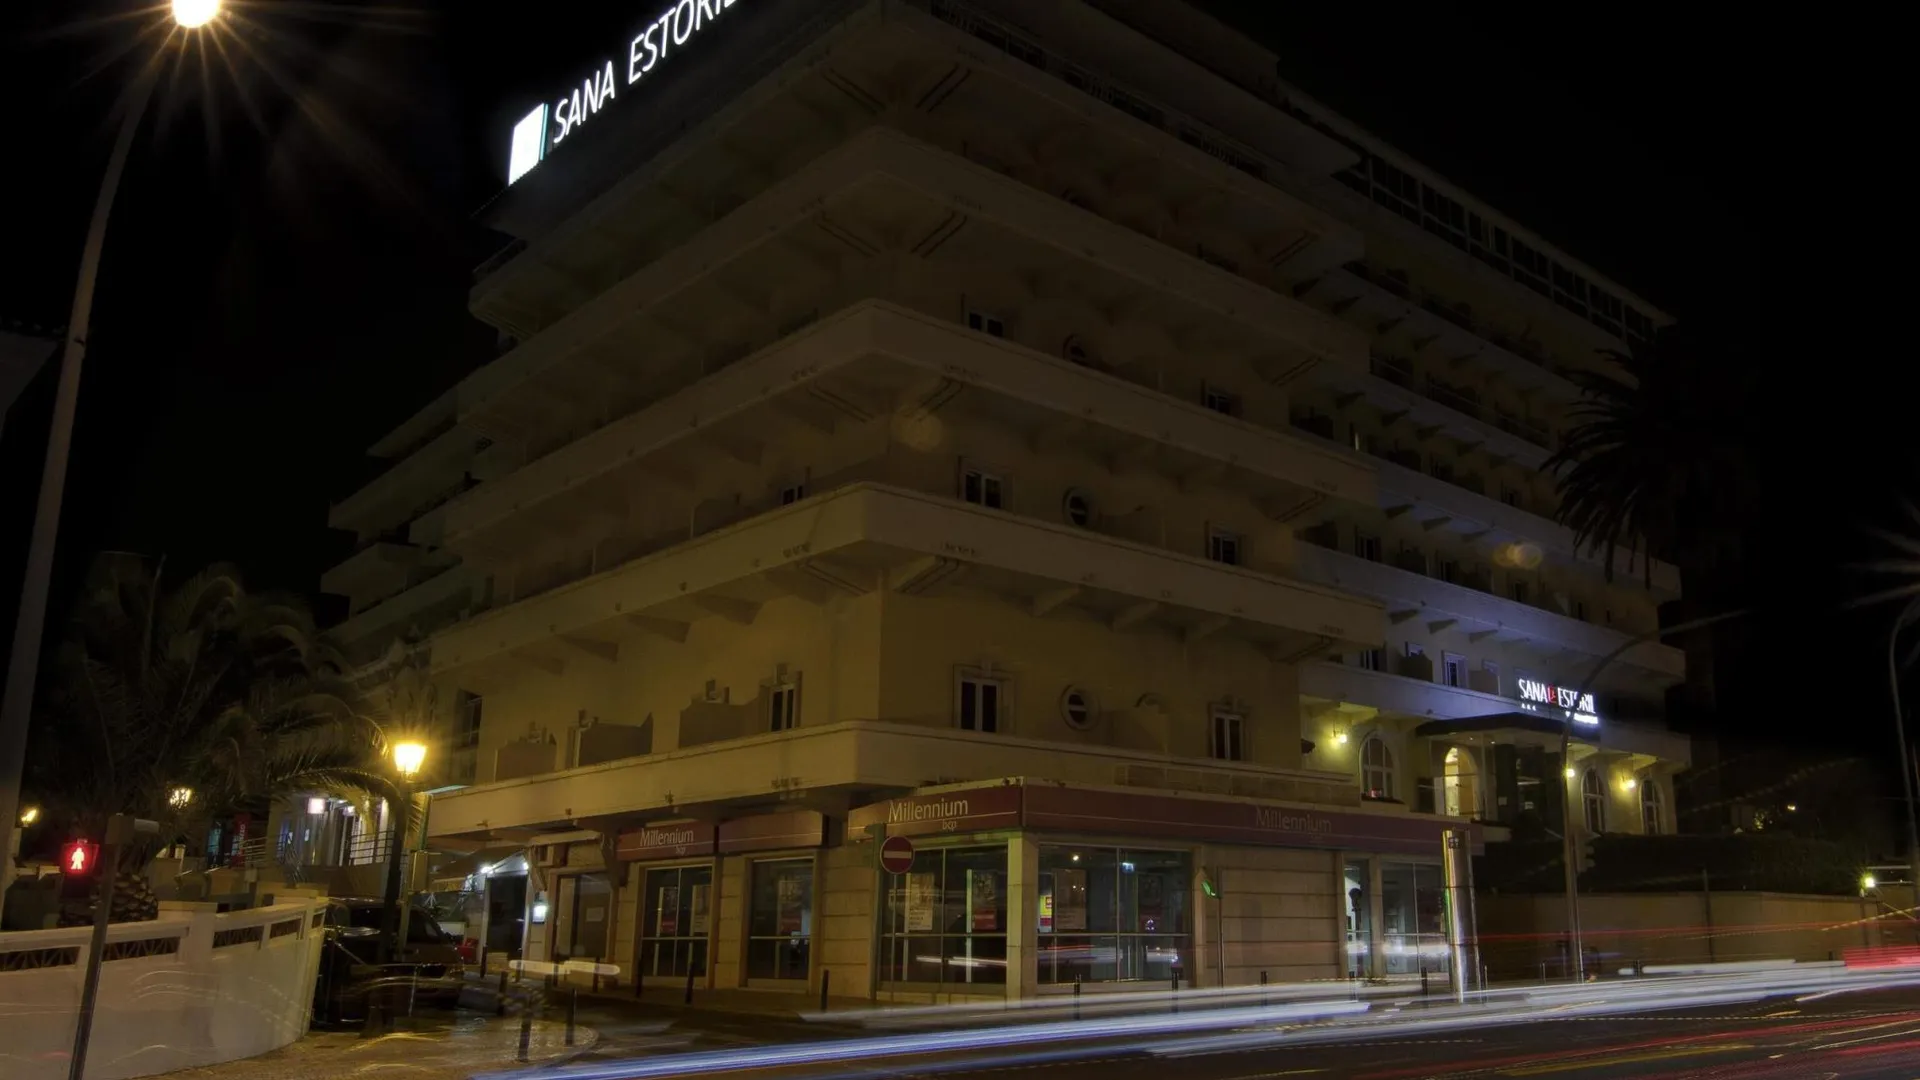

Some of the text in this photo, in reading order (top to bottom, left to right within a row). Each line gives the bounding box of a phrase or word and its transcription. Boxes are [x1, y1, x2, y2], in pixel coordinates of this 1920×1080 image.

[553, 0, 737, 144] SANA ESTOR
[1518, 678, 1549, 704] SANA
[888, 797, 969, 823] Millennium
[1255, 807, 1332, 833] Millennium
[639, 828, 694, 847] Millennium
